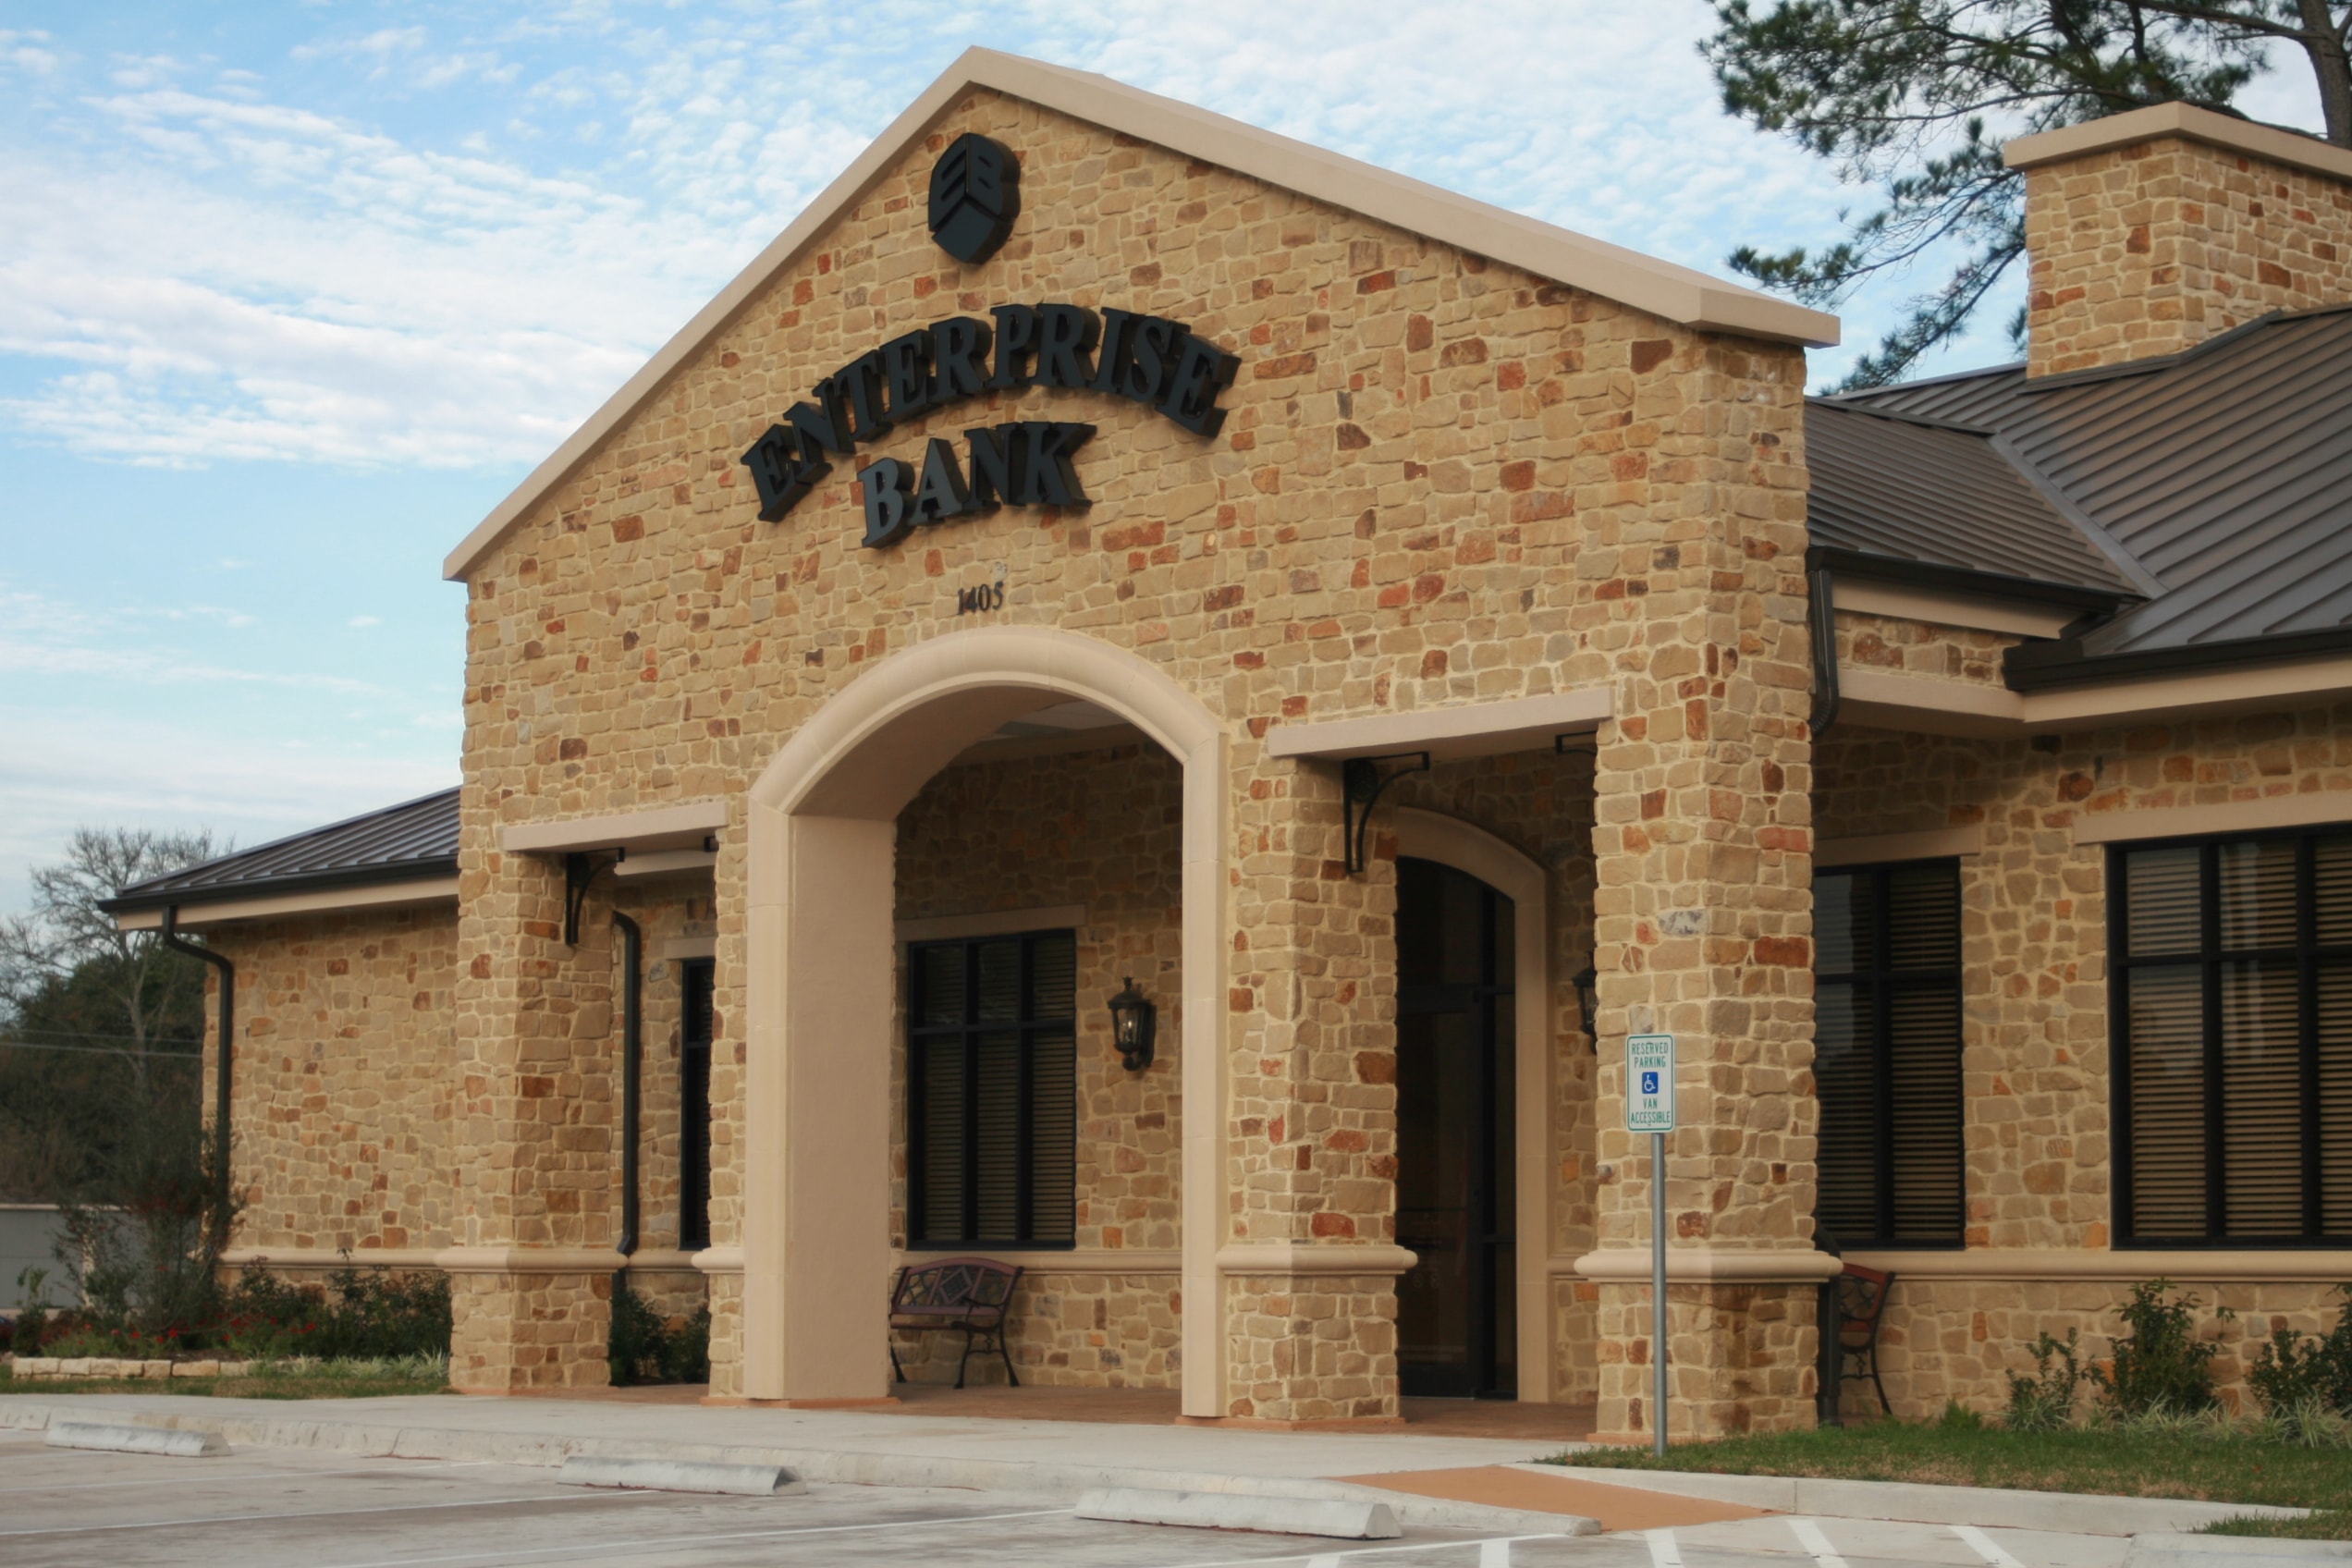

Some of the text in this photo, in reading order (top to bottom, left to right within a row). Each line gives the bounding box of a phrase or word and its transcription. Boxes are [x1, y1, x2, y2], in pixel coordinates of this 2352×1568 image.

[741, 303, 1242, 522] ENTERPRISE
[856, 421, 1097, 548] BANK
[958, 581, 1004, 616] 1405
[1631, 1042, 1669, 1055] RESERVED
[1634, 1056, 1666, 1068] PARKING
[1643, 1097, 1658, 1109] VAN
[1630, 1111, 1671, 1123] ACCESSIBLE
